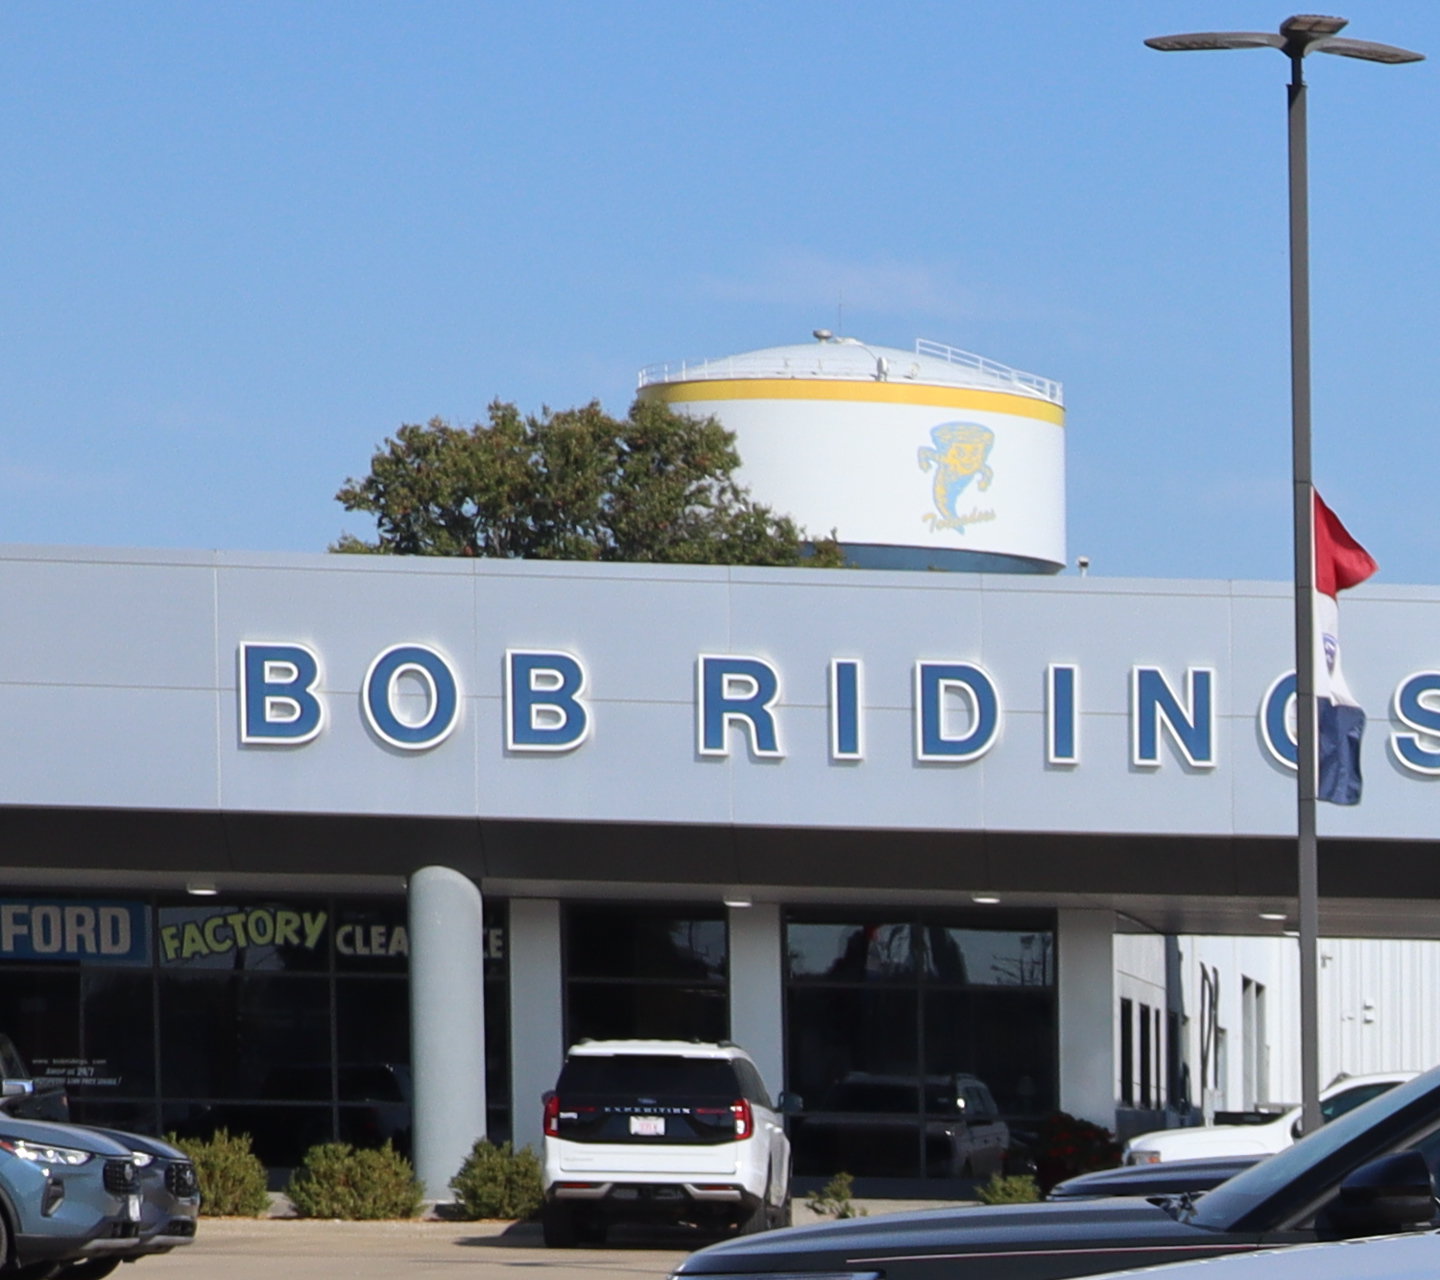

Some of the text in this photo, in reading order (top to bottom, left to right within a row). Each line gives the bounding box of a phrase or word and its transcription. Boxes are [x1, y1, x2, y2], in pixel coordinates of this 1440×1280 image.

[237, 640, 592, 754] BOB
[1, 904, 132, 955] FORD
[160, 909, 504, 961] FACTORY CLEAE
